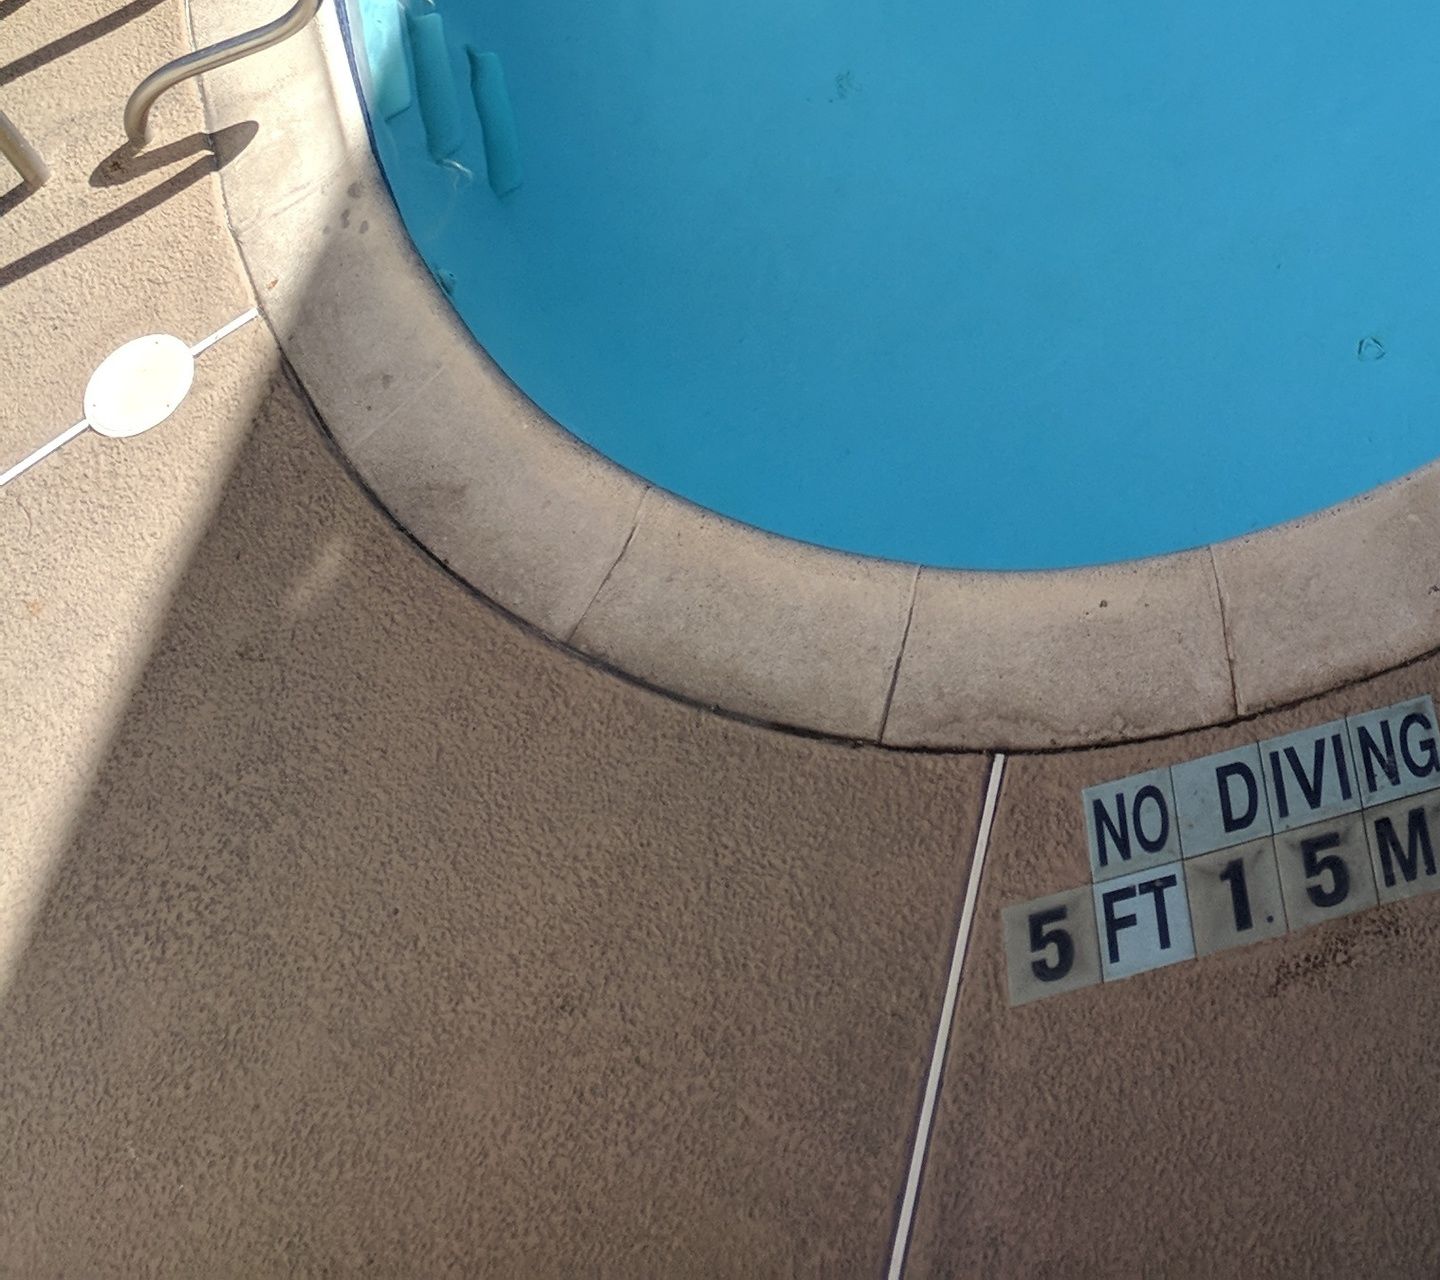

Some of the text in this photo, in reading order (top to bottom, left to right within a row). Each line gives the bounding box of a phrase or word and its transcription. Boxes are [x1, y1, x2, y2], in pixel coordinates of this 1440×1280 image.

[1092, 783, 1170, 867] NO
[1027, 904, 1076, 983] 5
[1100, 872, 1178, 965] FT
[1374, 806, 1438, 888] M
